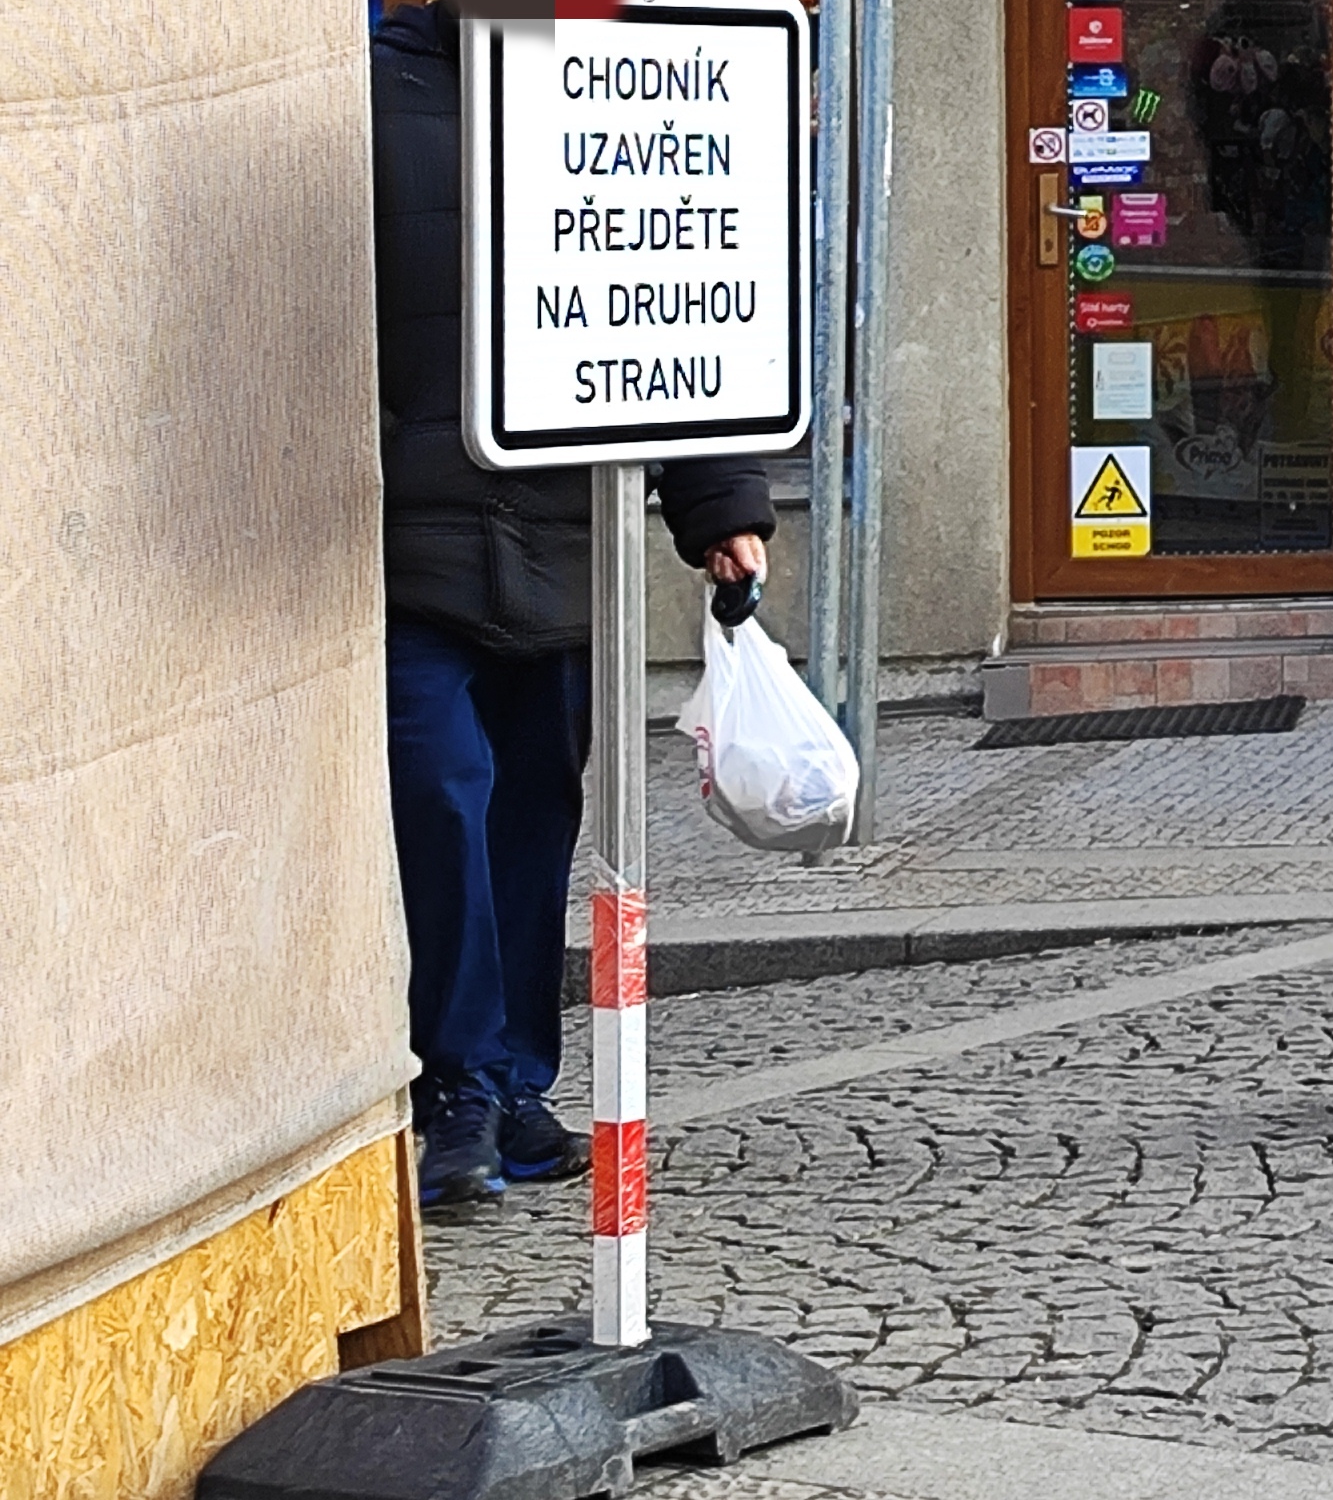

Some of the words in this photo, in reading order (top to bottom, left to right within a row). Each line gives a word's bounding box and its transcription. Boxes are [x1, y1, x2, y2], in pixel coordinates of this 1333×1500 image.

[562, 46, 730, 102] CHODNÍK
[563, 119, 731, 176] UZAVŘEN
[554, 195, 740, 252] PŘEJDĚTE
[536, 284, 589, 329] NA
[607, 280, 757, 328] DRUHOU
[574, 354, 722, 404] STRANU
[1092, 529, 1131, 538] POZOR
[1092, 541, 1131, 551] SCHOD
